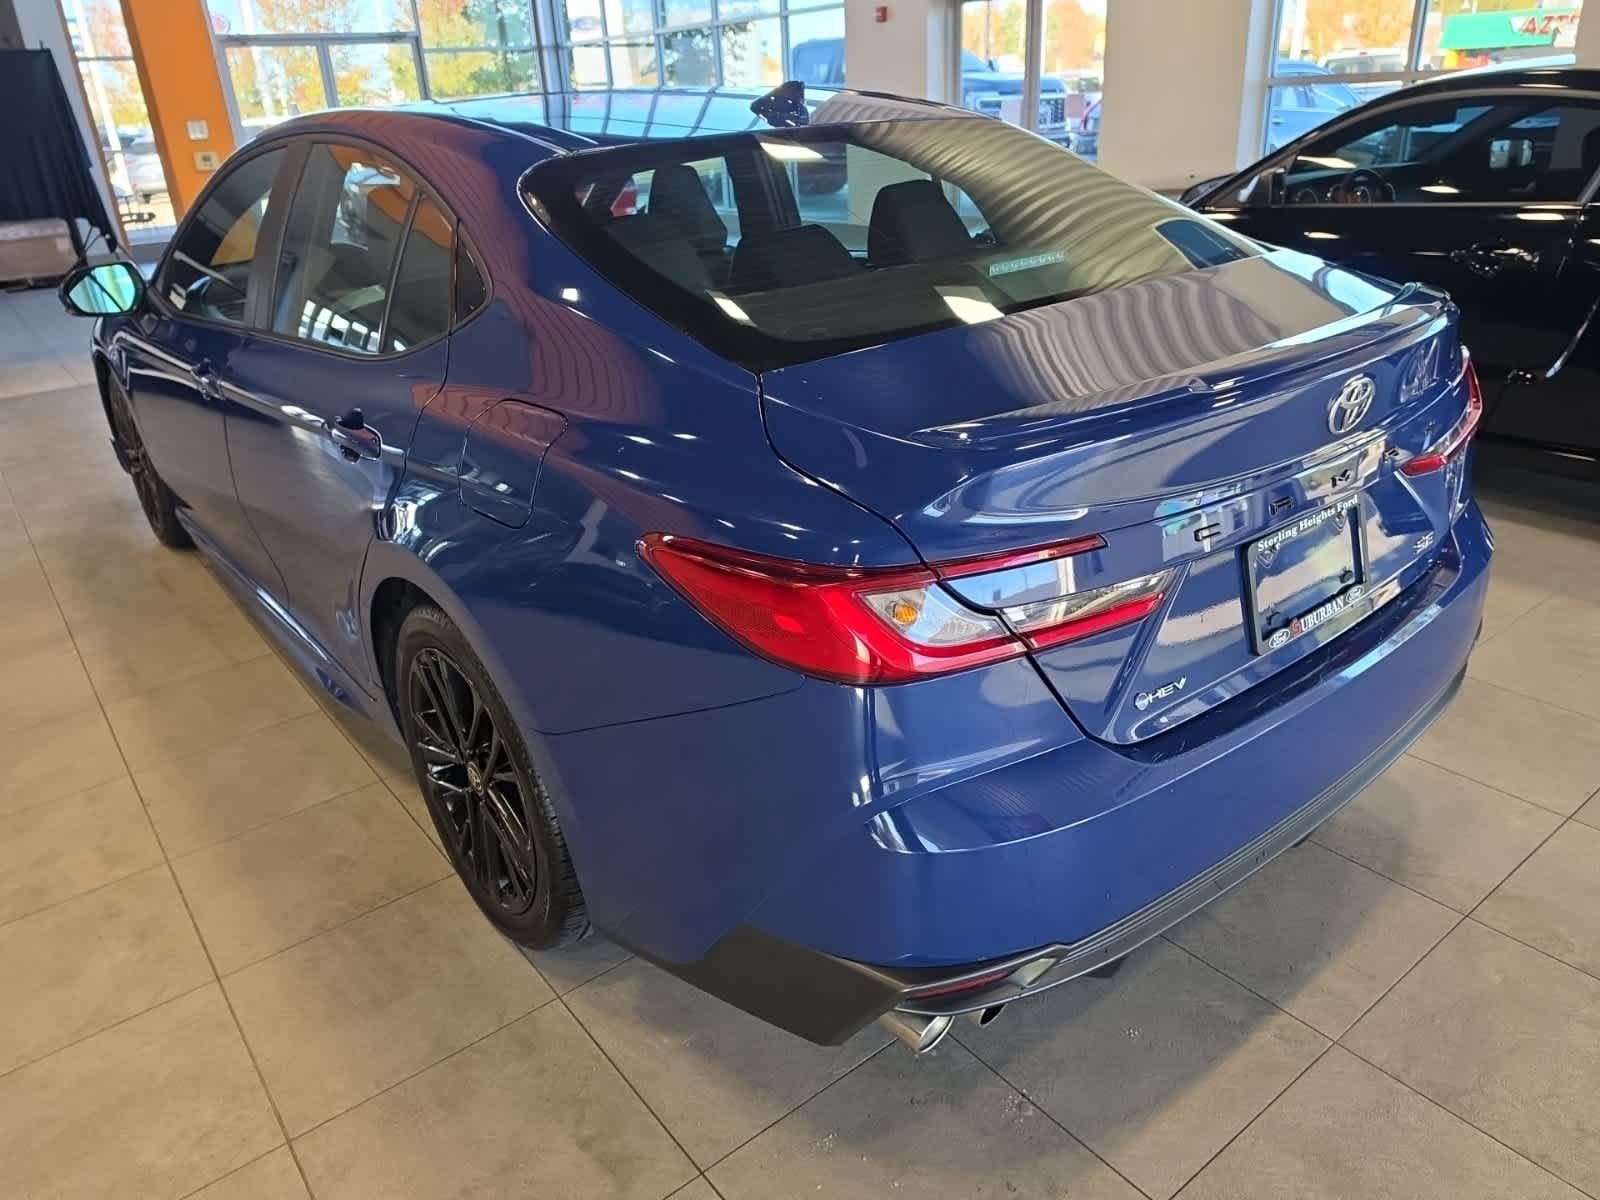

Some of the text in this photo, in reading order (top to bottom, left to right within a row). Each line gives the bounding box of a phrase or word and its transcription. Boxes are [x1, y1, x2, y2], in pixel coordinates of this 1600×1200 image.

[1257, 494, 1358, 552] Sterling Heights Ford
[1290, 595, 1346, 637] SUBURBAN
[1148, 677, 1187, 704] HEV
